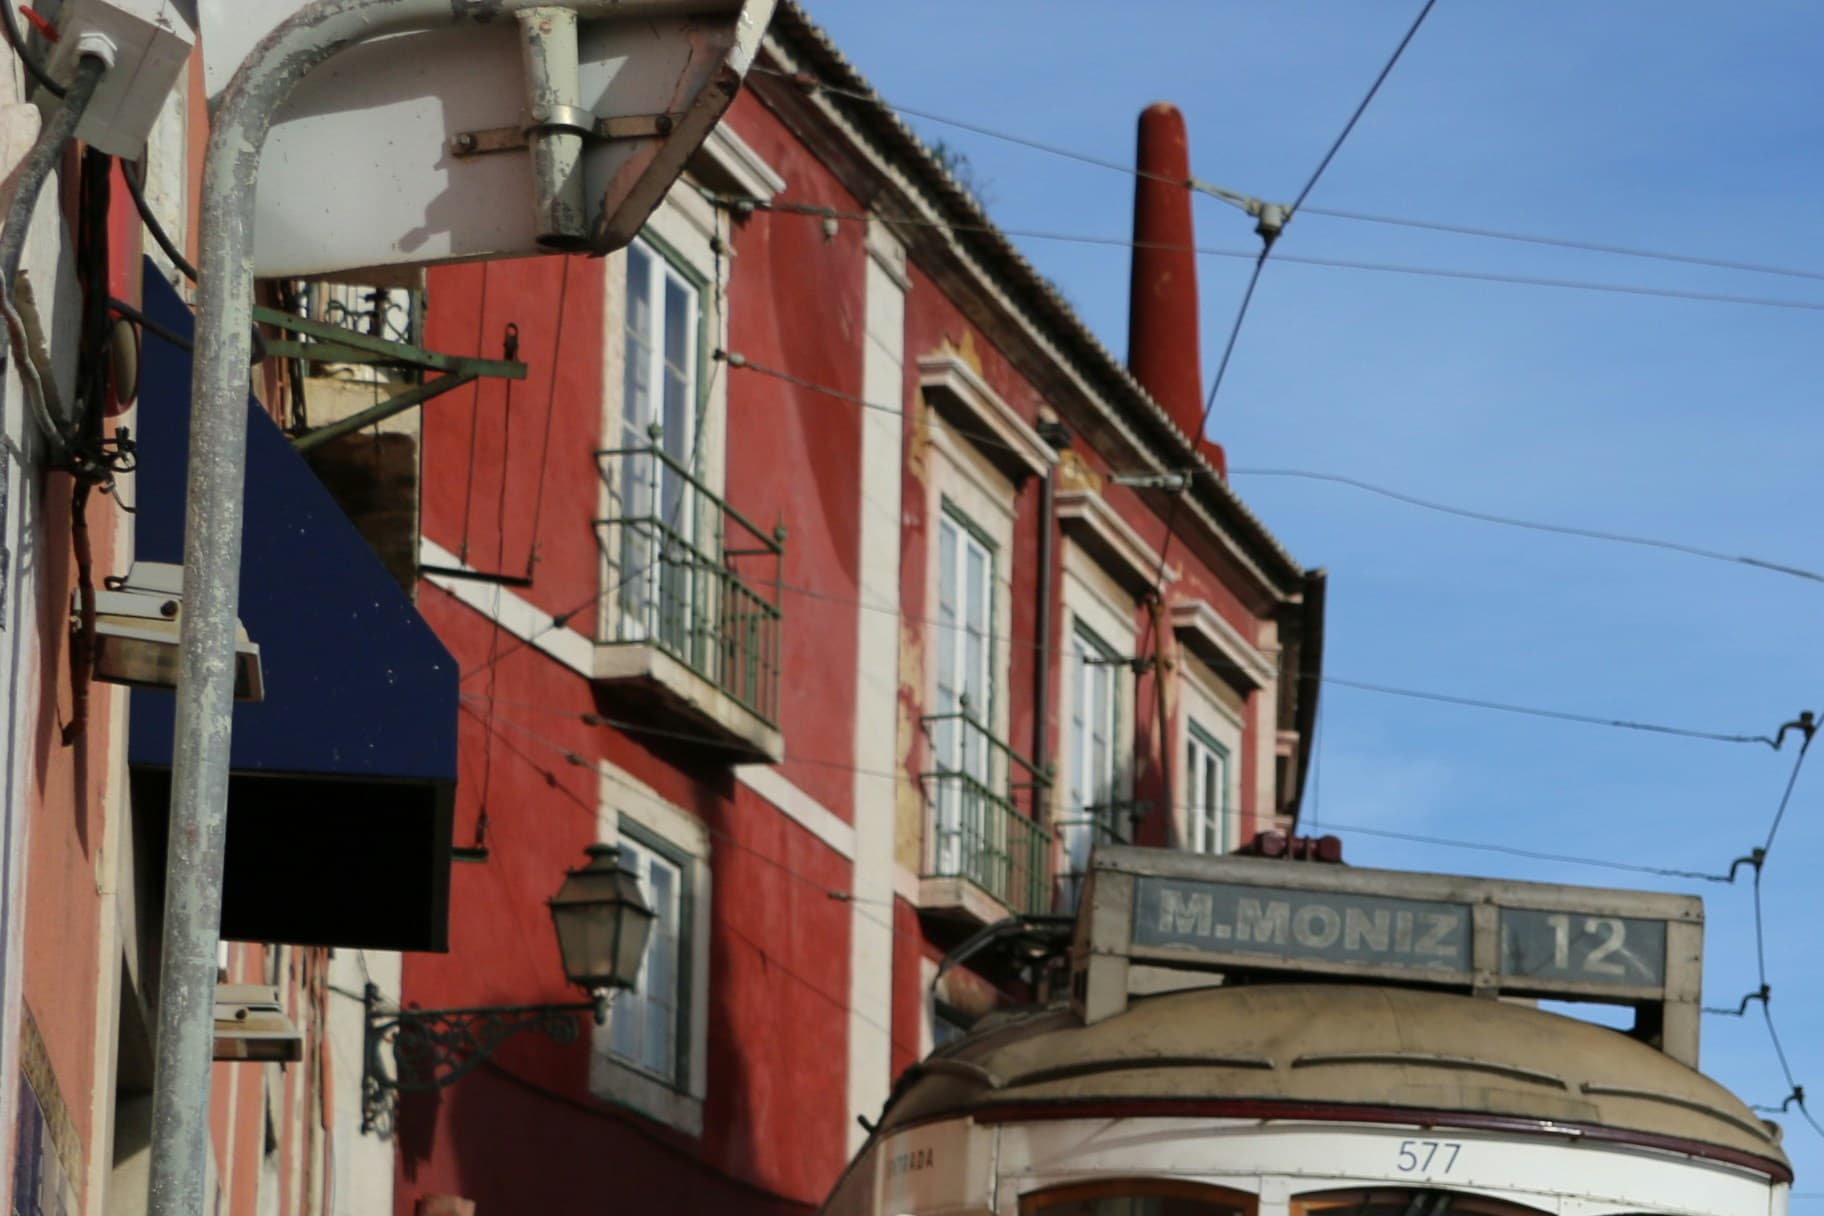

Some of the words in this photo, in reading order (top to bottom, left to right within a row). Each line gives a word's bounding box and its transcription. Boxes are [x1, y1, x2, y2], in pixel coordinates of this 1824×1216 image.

[1158, 887, 1459, 957] M.MONIZ
[1547, 914, 1626, 976] 12
[1397, 1140, 1462, 1174] 577
